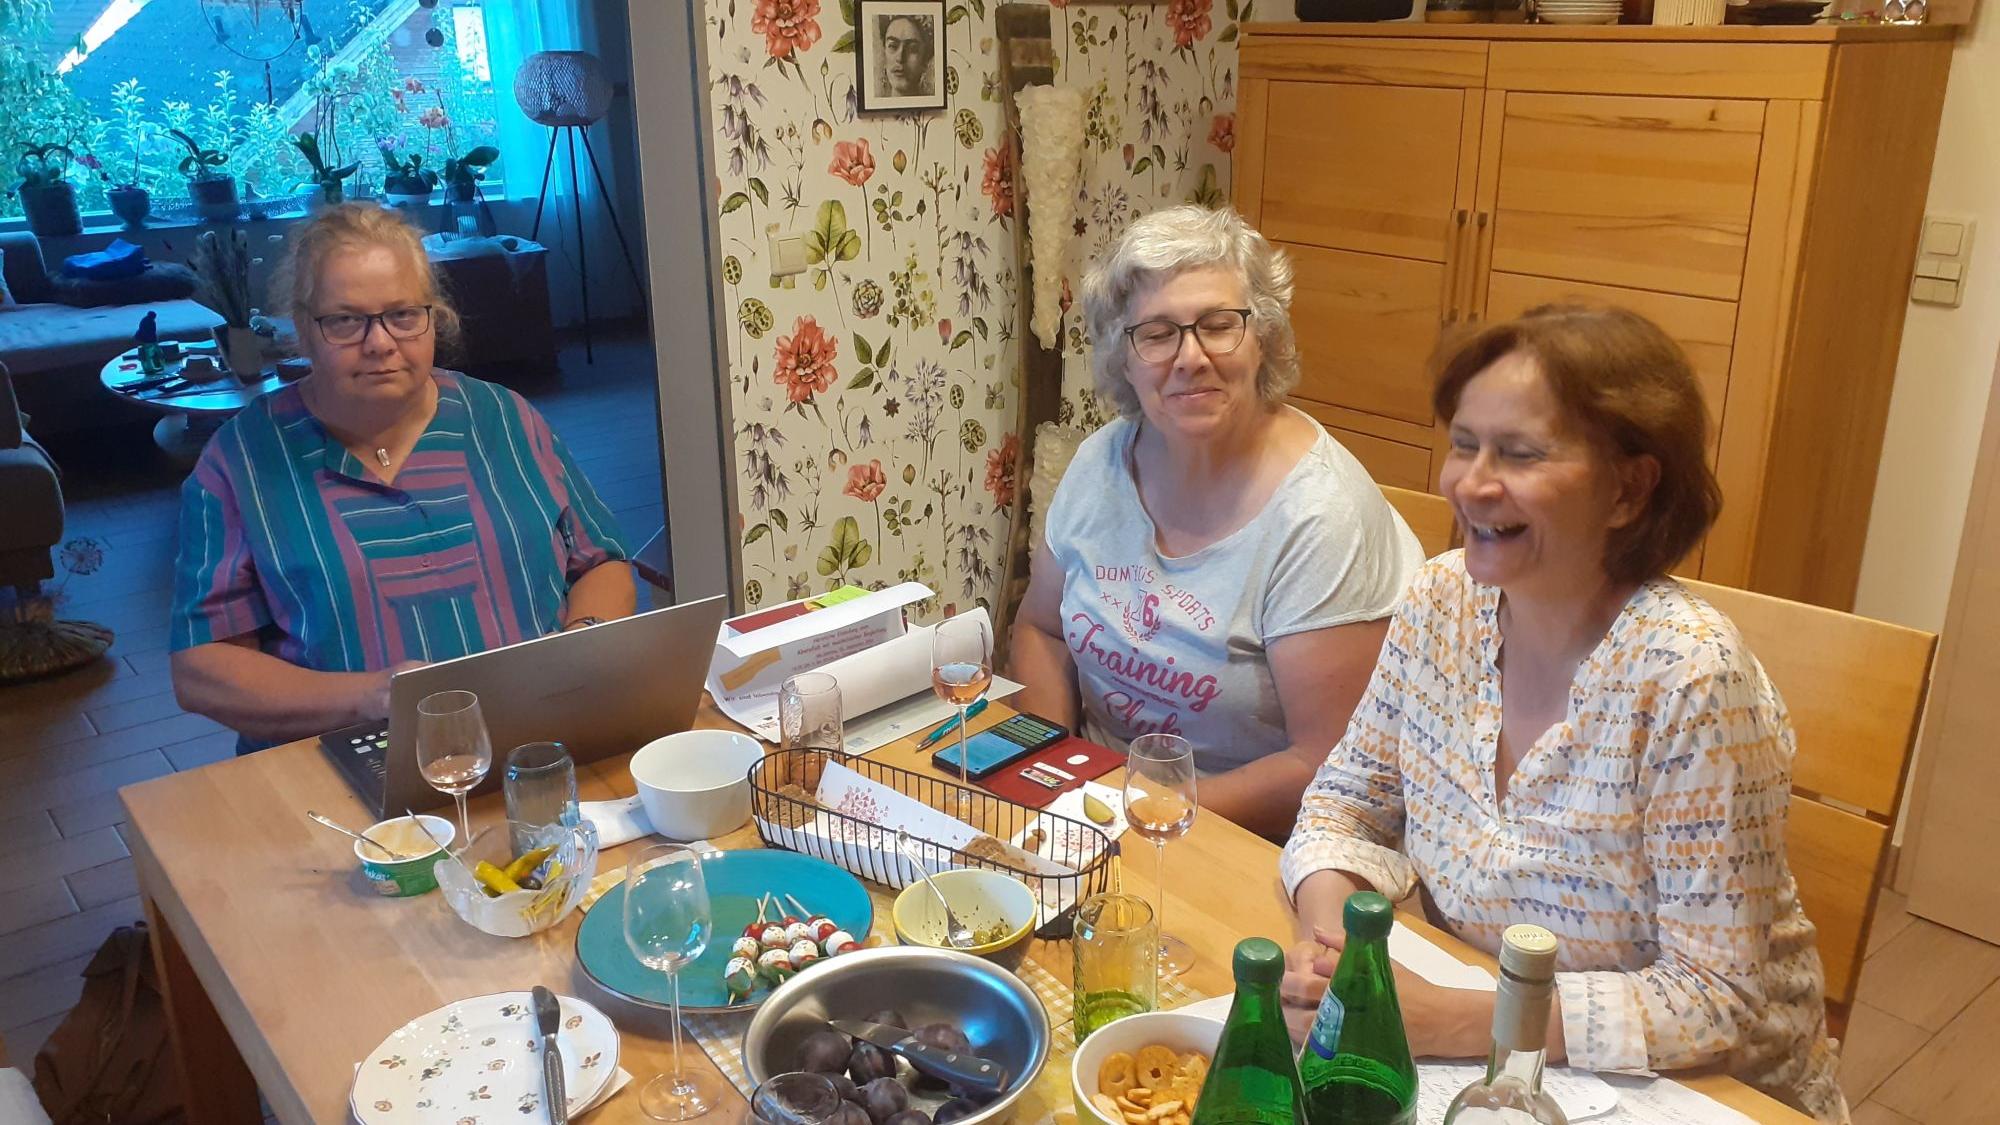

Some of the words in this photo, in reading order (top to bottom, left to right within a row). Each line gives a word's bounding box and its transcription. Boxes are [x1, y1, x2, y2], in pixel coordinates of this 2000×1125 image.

[1161, 584, 1215, 631] SPORTS
[1069, 612, 1222, 712] Training
[1103, 691, 1182, 748] Club
